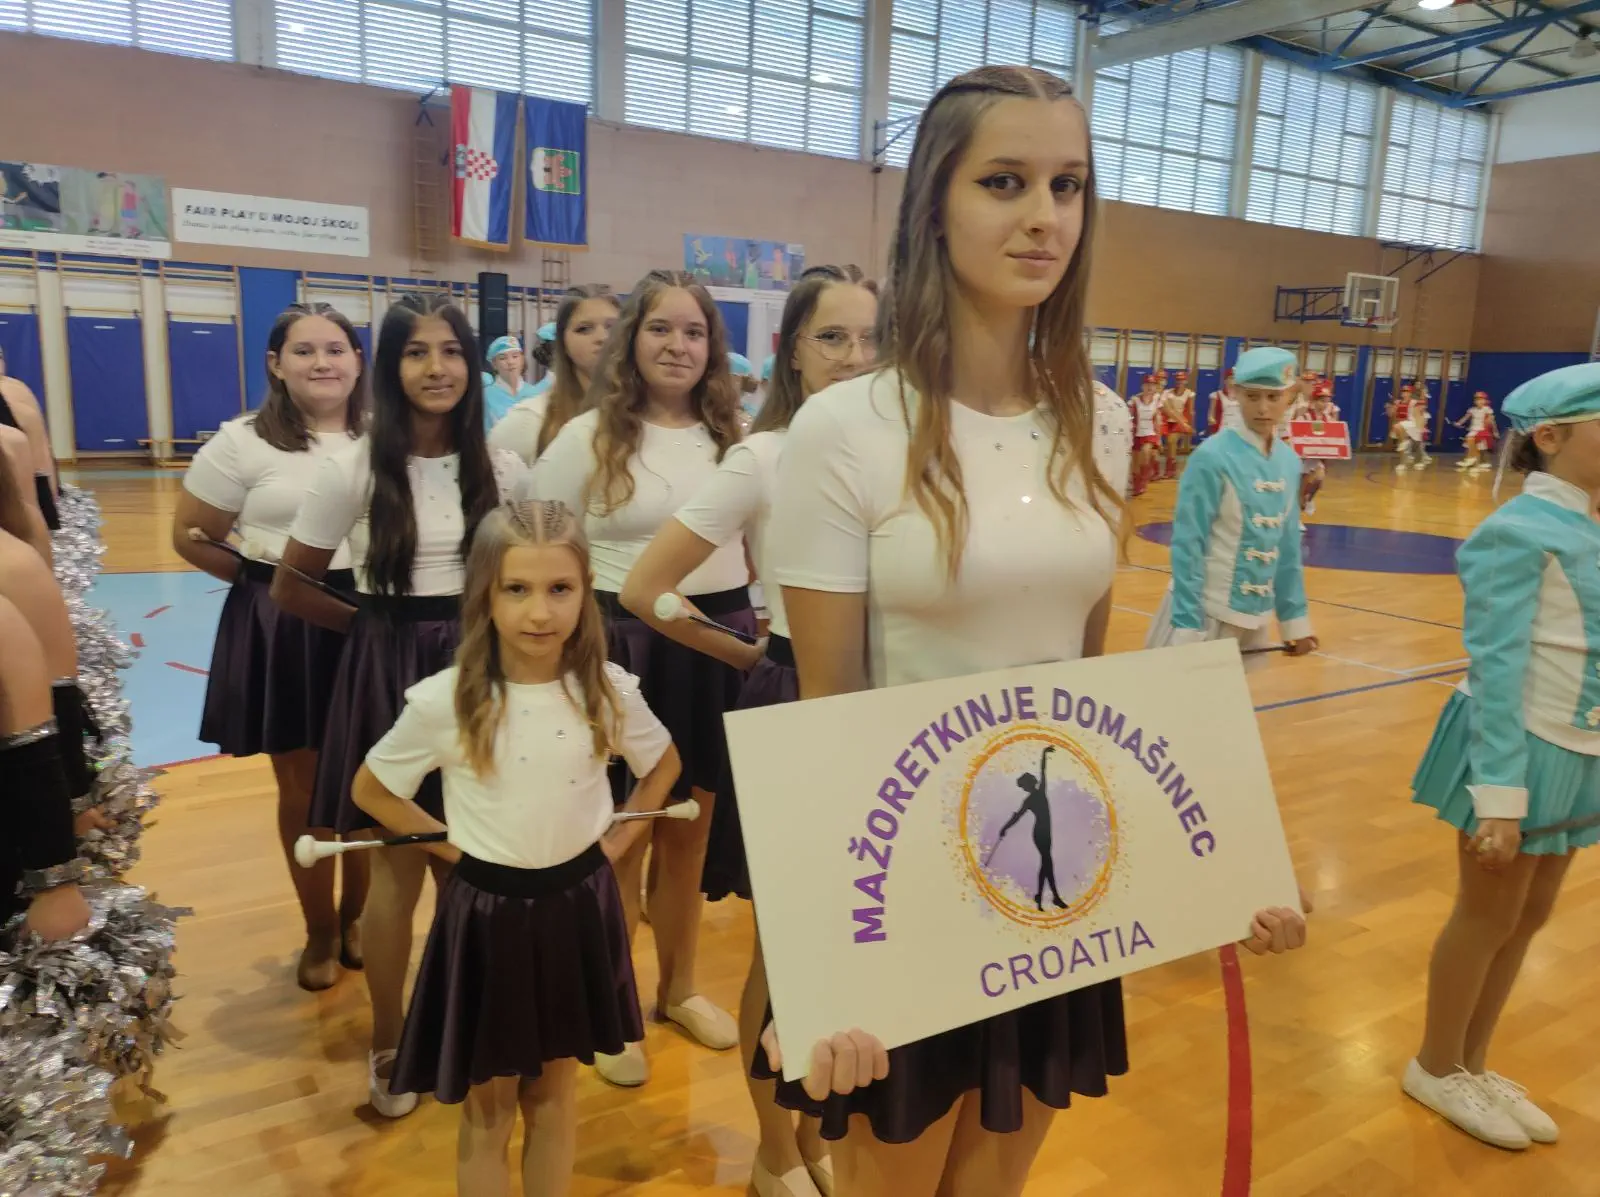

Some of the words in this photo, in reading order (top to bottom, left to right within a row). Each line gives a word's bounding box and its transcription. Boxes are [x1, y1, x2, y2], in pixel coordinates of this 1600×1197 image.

[184, 204, 216, 216] FAIR
[220, 208, 257, 219] PLAY
[259, 212, 268, 221] U
[272, 213, 317, 225] MOJOJ
[320, 216, 359, 229] ŠKOLI
[848, 686, 1037, 944] MAŽORETKINJE
[1052, 687, 1217, 858] DOMAŠINEC
[980, 920, 1156, 998] CROATIA
